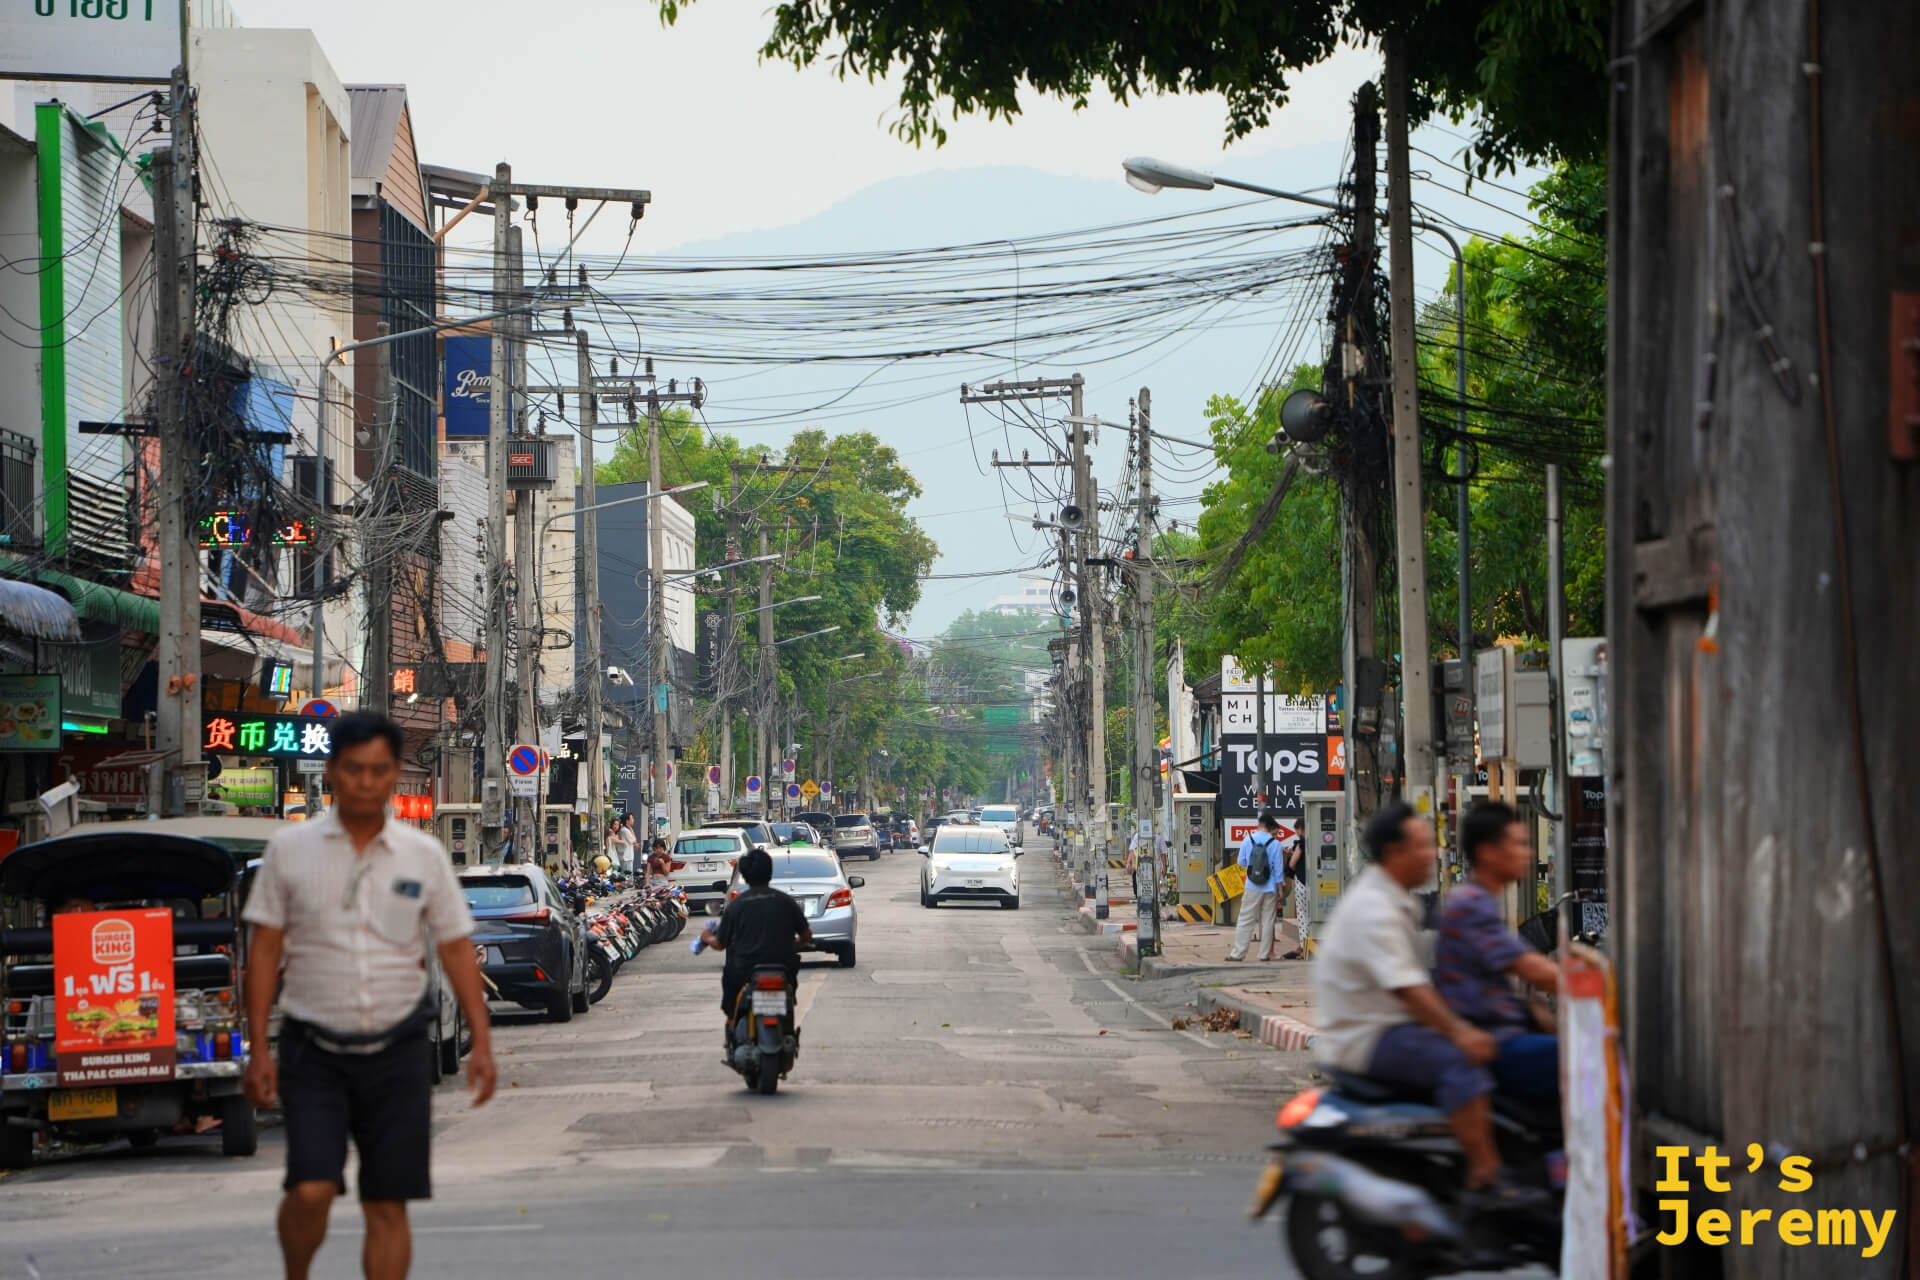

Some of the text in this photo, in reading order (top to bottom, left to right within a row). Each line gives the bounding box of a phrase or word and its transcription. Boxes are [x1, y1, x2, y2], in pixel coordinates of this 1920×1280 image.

[203, 718, 331, 754] 货币兑换
[1227, 744, 1320, 782] Tops
[1243, 785, 1301, 796] WINE
[95, 932, 132, 942] BURGER
[96, 941, 132, 954] KING
[81, 1052, 151, 1067] BURGER KING
[63, 1065, 170, 1081] THA PAE CHIANG MAI
